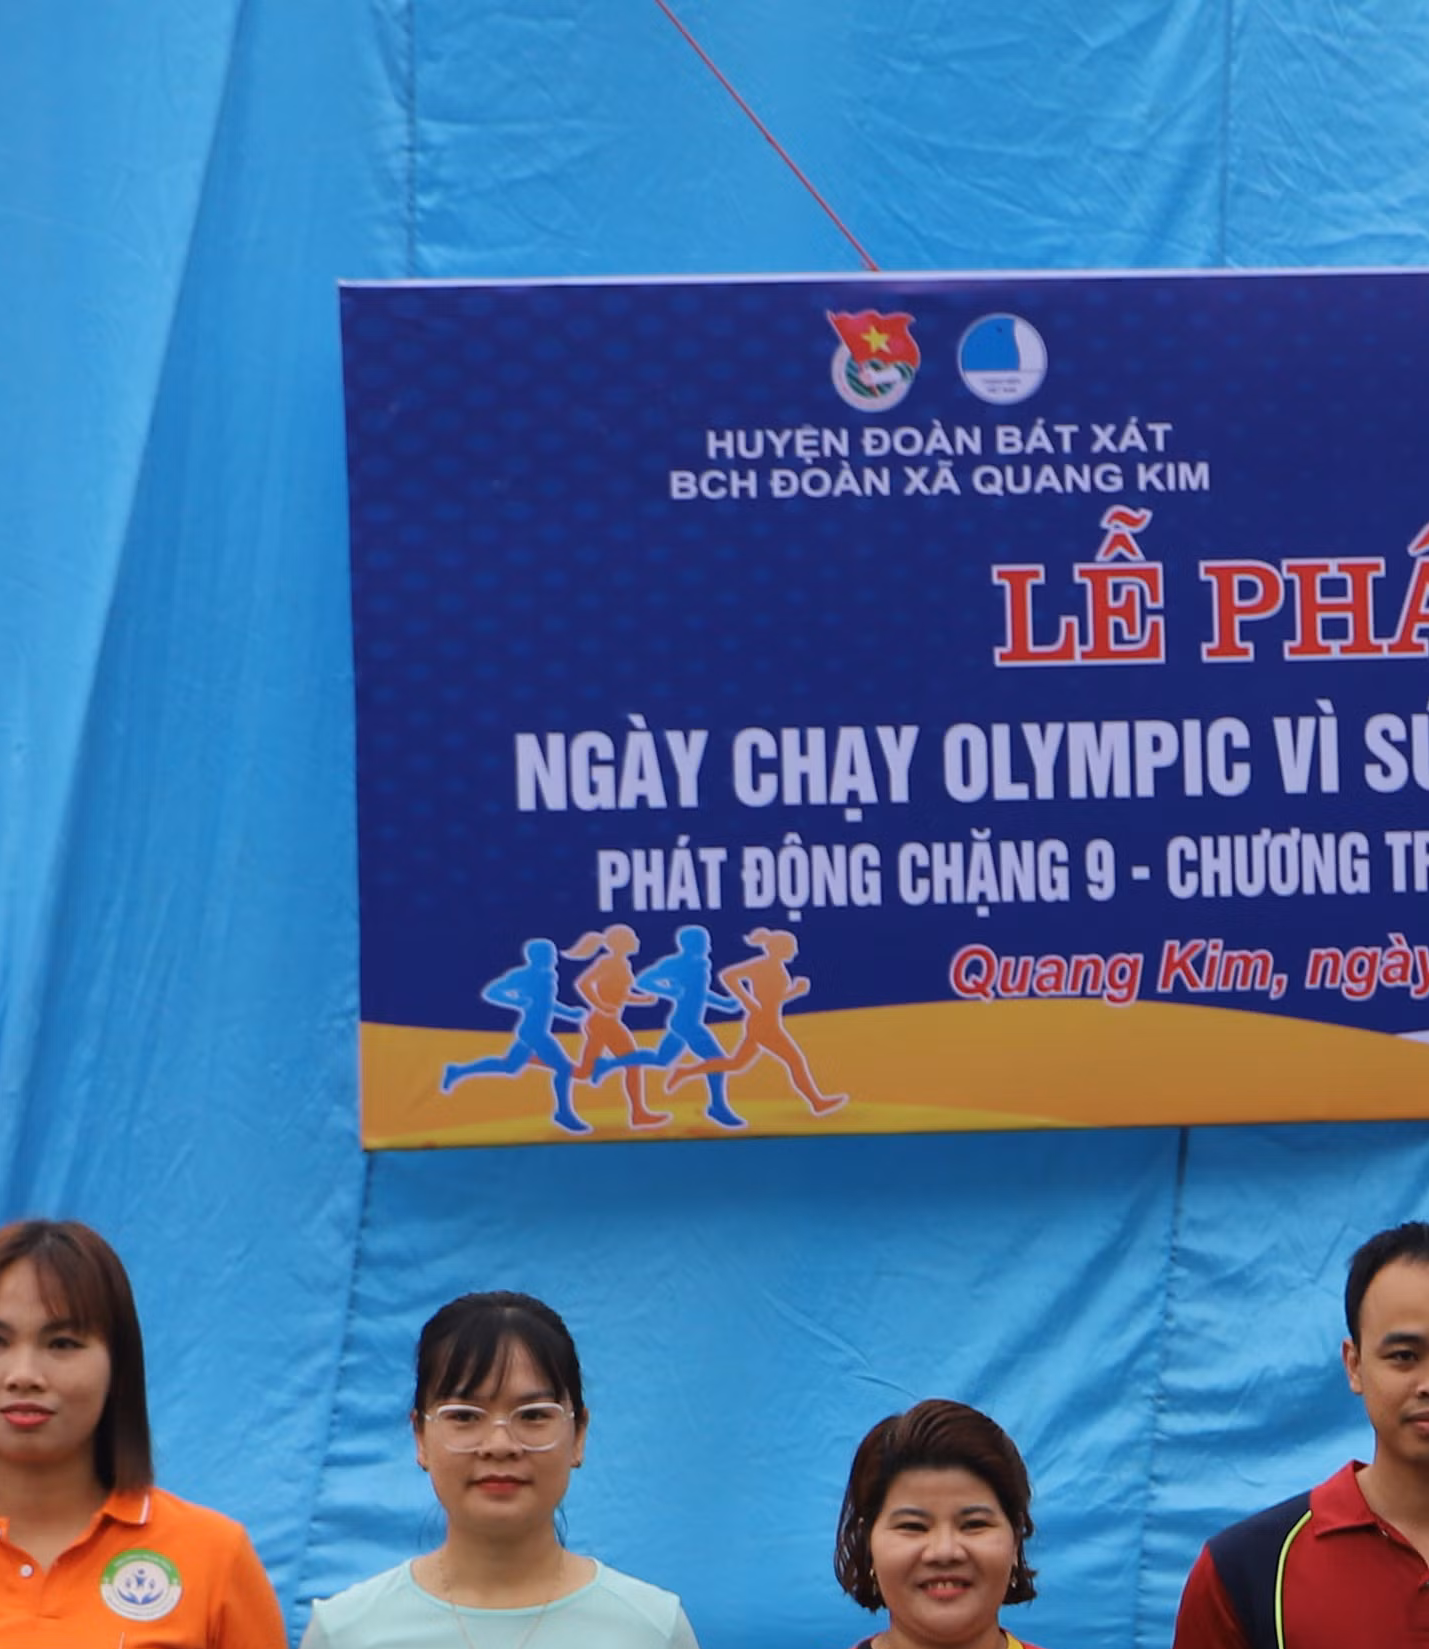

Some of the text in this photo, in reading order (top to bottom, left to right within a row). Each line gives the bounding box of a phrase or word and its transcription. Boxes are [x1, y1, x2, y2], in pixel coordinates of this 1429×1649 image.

[669, 461, 1210, 499] BCH ĐOÀN XÃ QUANG KIM
[706, 416, 1172, 464] HUYỆN ĐOÀN BÁT XÁT
[991, 504, 1165, 666] LỄ
[514, 713, 708, 811] NGÀY
[731, 724, 918, 822] CHẠY
[942, 717, 1250, 803] OLYMPIC
[1272, 697, 1339, 794] VÌ
[596, 835, 727, 911] PHÁT
[742, 831, 882, 920] ĐỘNG
[898, 827, 1069, 917] CHẶNG
[1084, 845, 1115, 901] 9
[1167, 827, 1370, 899] CHƯƠNG
[949, 945, 1144, 1005] Quang
[1157, 937, 1290, 997] Kim,
